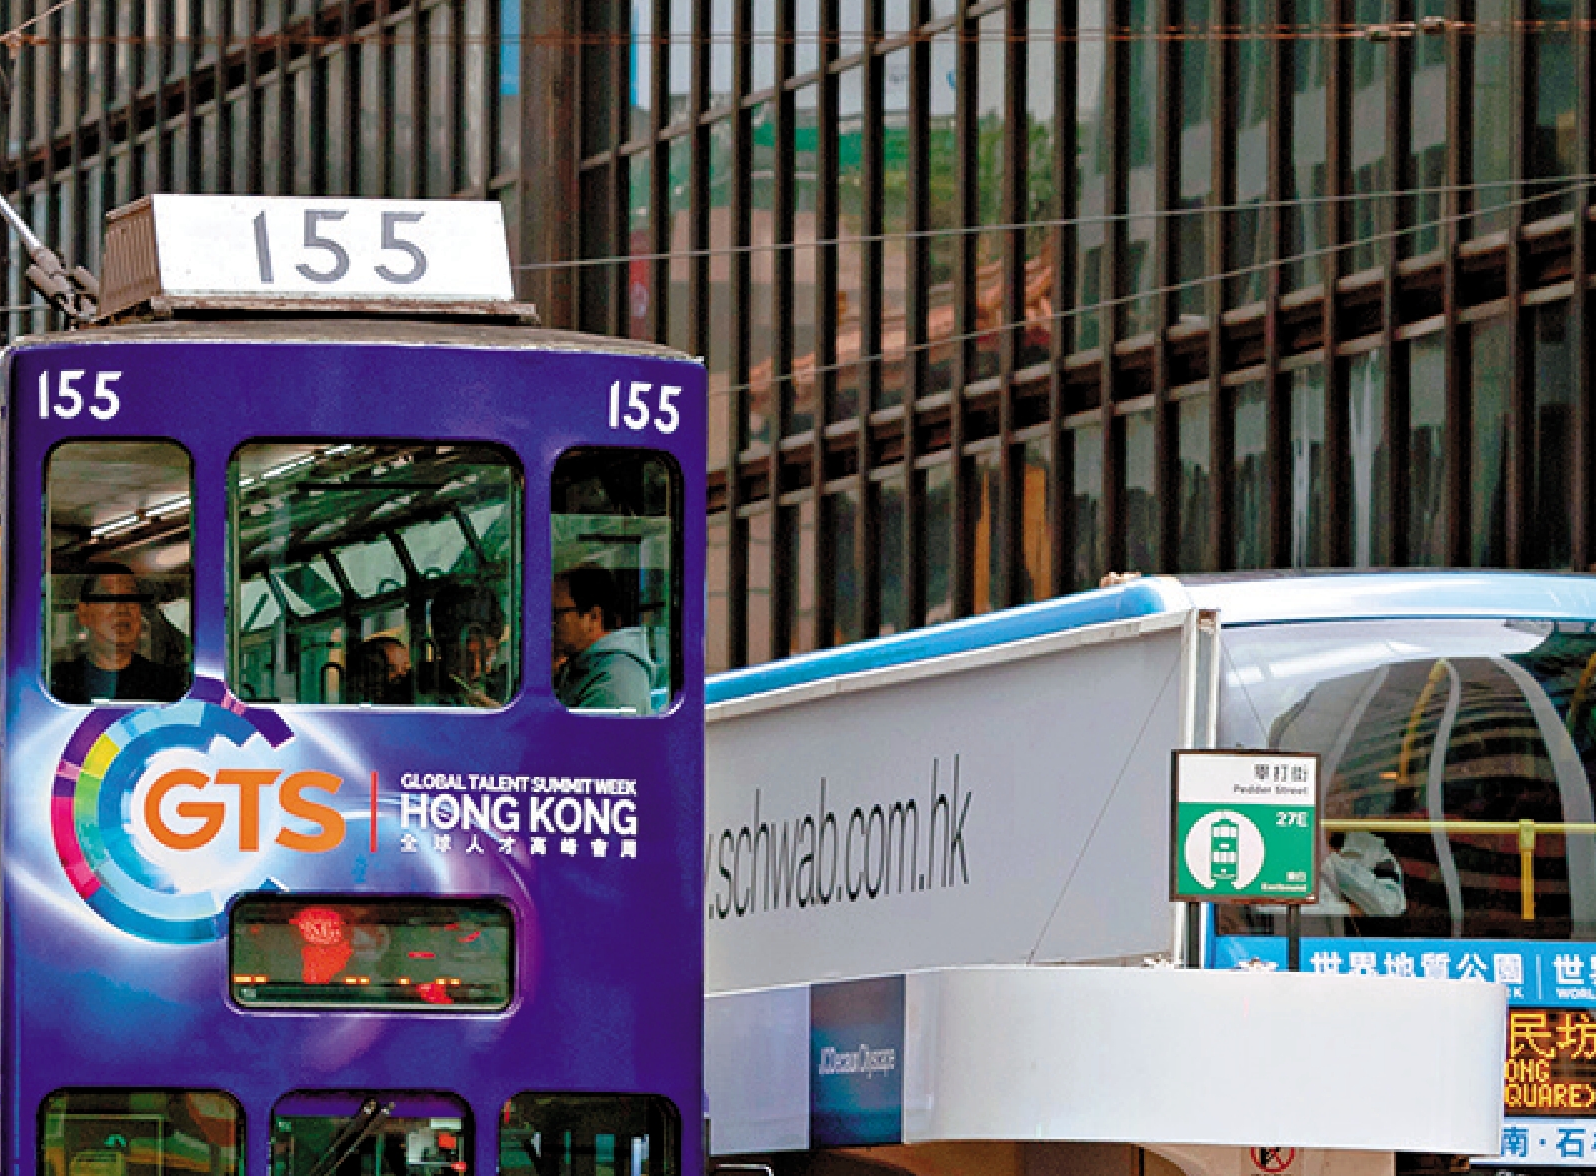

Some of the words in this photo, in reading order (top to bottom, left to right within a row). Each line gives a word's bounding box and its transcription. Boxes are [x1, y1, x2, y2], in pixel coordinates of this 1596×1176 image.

[253, 209, 429, 284] 155
[38, 369, 123, 421] 155
[608, 380, 683, 435] 155
[143, 766, 347, 853] GTS
[401, 772, 466, 789] GLOBAL
[468, 774, 530, 793] TALENT
[531, 776, 592, 795] SUMMIT
[595, 778, 638, 798] WEEK
[400, 792, 521, 834] HONG
[530, 796, 639, 836] KONG
[705, 752, 973, 921] .schwab.com.hk
